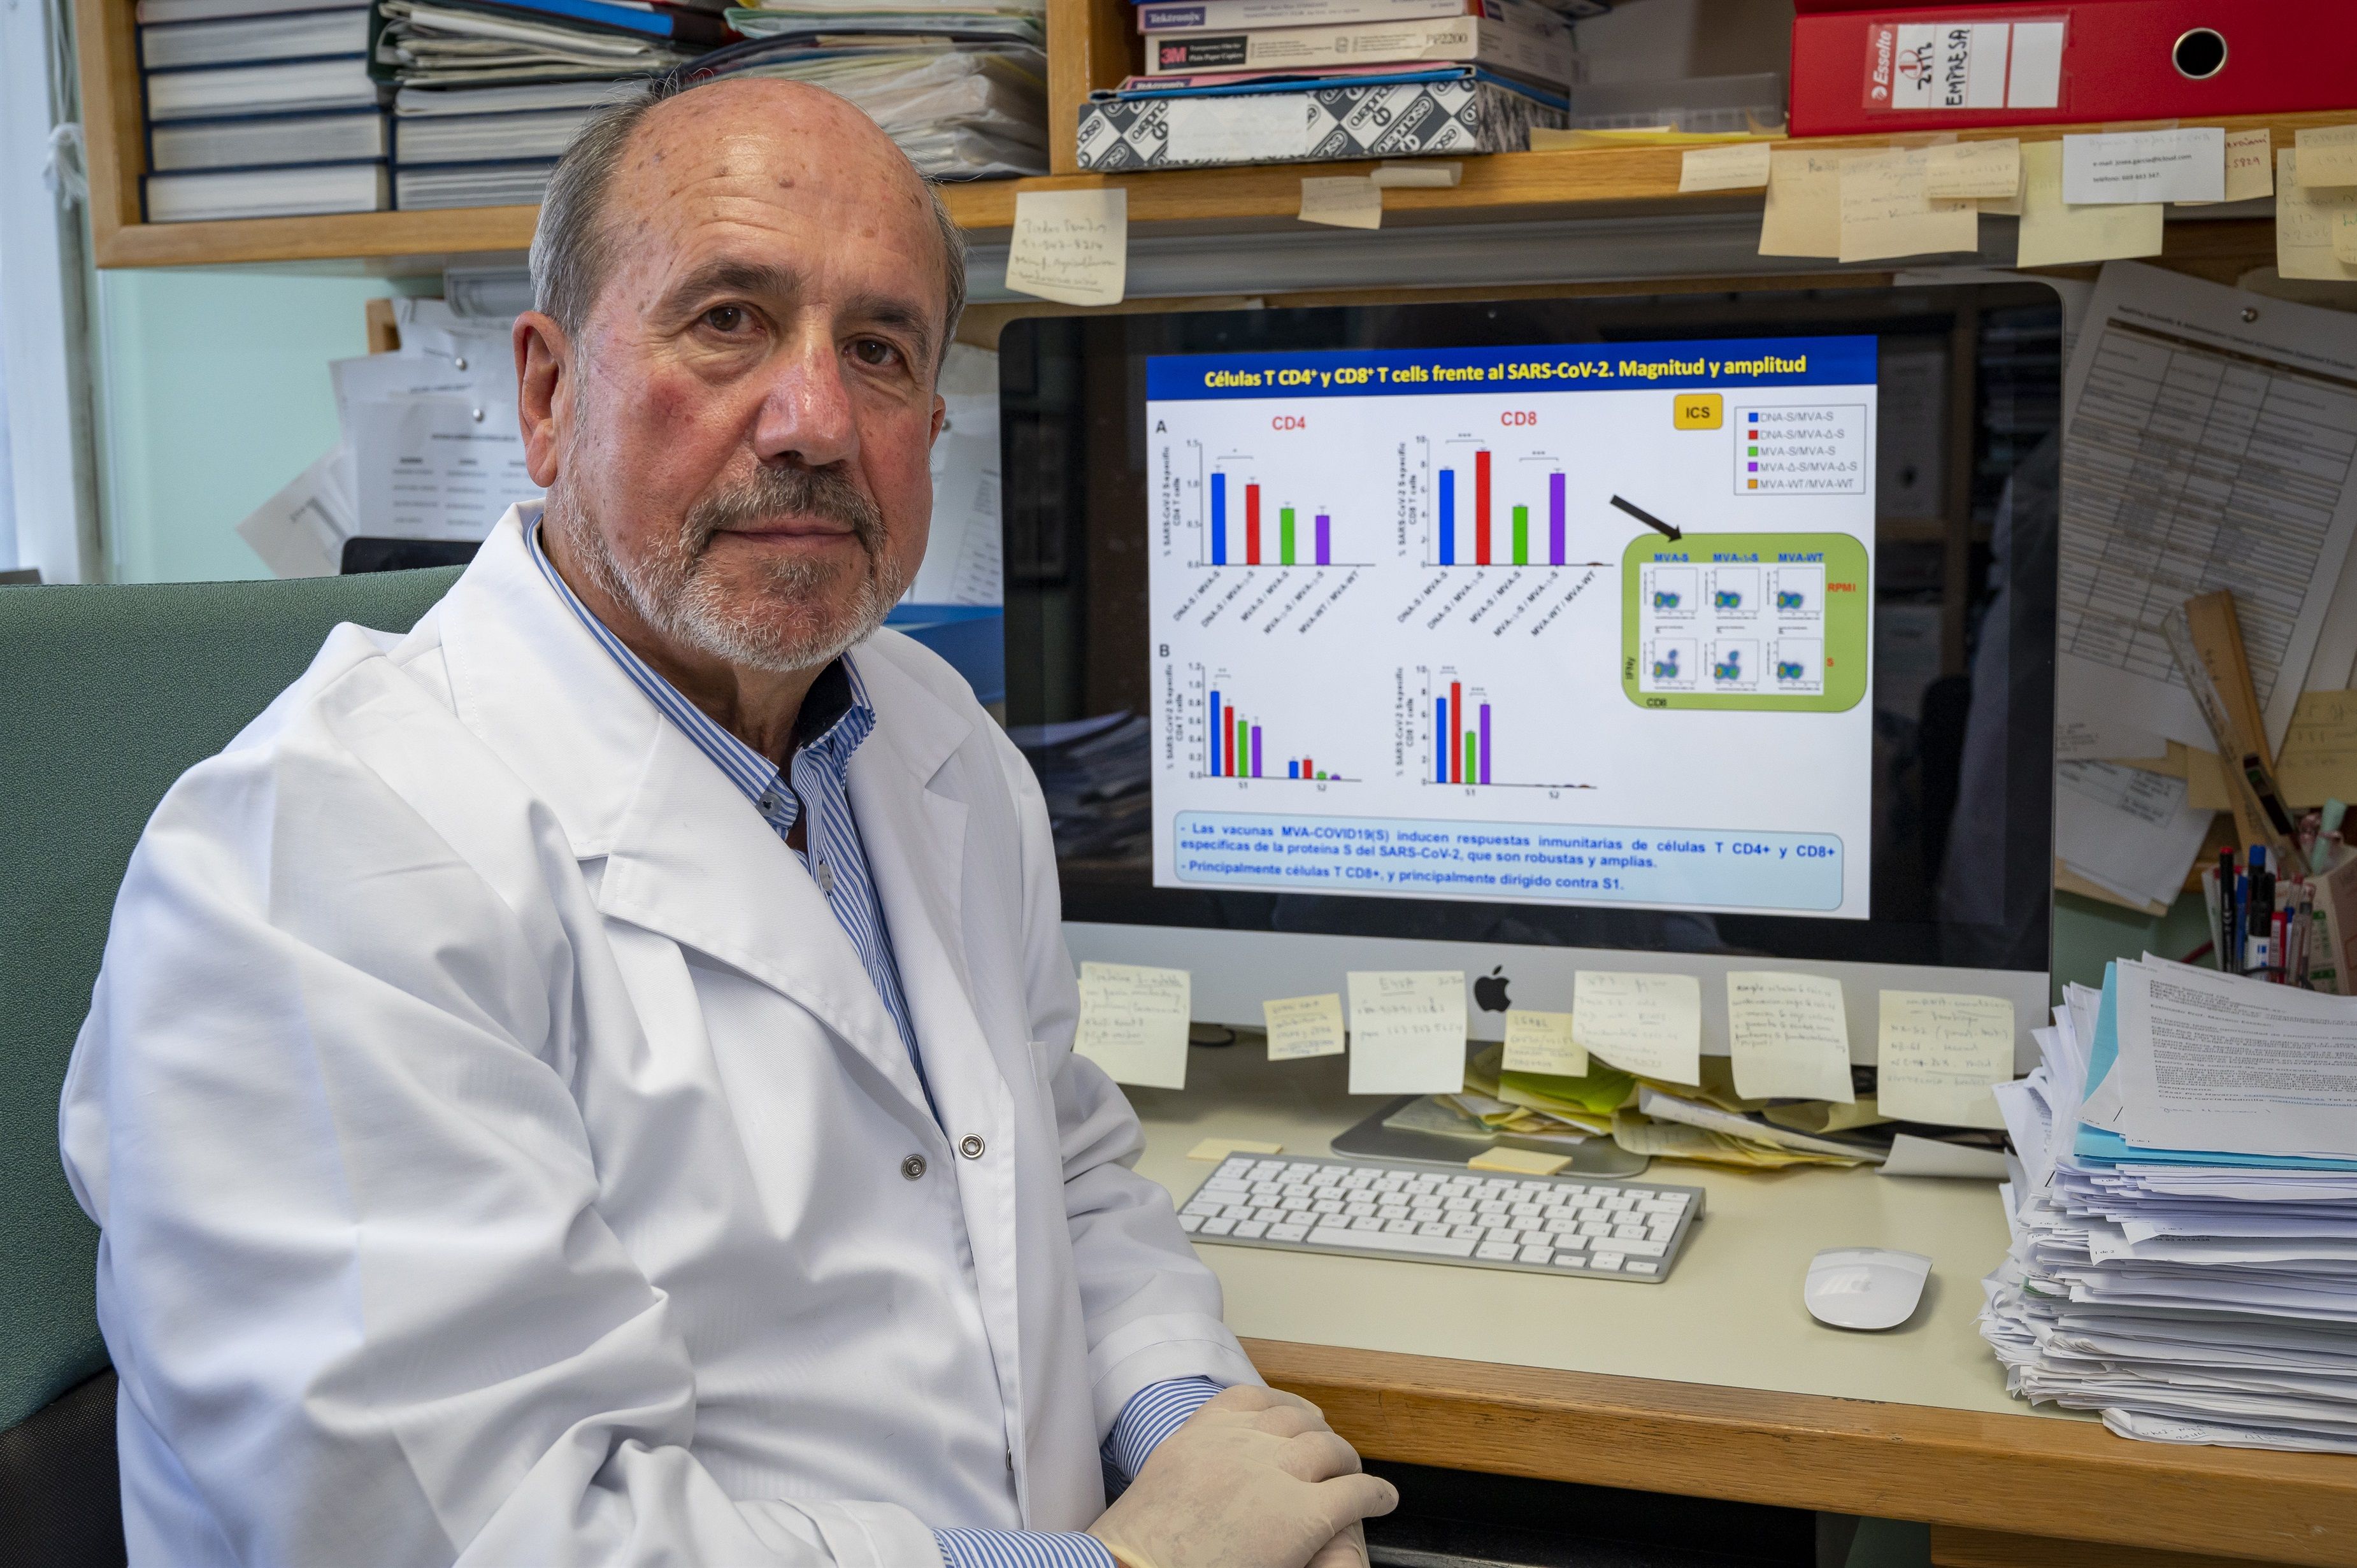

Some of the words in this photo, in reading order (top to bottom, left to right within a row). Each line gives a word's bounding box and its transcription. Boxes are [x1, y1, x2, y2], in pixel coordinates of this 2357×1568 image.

[1160, 46, 1187, 64] 3M
[1873, 30, 1892, 85] Esselte
[1945, 29, 1970, 106] EMPRESA
[1205, 369, 1261, 388] Células
[1264, 370, 1274, 386] T
[1278, 368, 1317, 386] CD4+
[1320, 371, 1331, 388] y
[1335, 366, 1375, 385] CD8+
[1377, 366, 1389, 383] T
[1391, 365, 1429, 383] cells
[1432, 364, 1484, 381] frente
[1488, 362, 1504, 380] al
[1507, 361, 1615, 380] SARS-CoV-2.
[1619, 357, 1705, 380] Magnitud
[1709, 360, 1721, 378] y
[1723, 355, 1807, 377] amplitud
[1501, 412, 1537, 426] CD8
[1686, 406, 1710, 418] ICS
[1760, 411, 1834, 422] DNA-S/MVA-S
[1156, 419, 1167, 434] A
[1272, 416, 1306, 431] CD4
[1760, 446, 1836, 456] MVA-S/MVA-S
[1760, 478, 1854, 489] MVA-WT/MVA-WT
[1654, 553, 1689, 562] MVA-S
[1778, 553, 1824, 562] MVA-WT
[1827, 583, 1856, 592] RPMI
[1159, 644, 1170, 657] B
[1192, 823, 1214, 834] Las
[1221, 826, 1274, 837] vacunas
[1282, 826, 1389, 844] MVA-COVID19(S)
[1396, 830, 1449, 843] inducen
[1456, 834, 1530, 850] respuestas
[1538, 836, 1623, 851] inmunitarias
[1631, 839, 1648, 852] de
[1656, 841, 1705, 853] células
[1716, 842, 1724, 853] T
[1732, 843, 1770, 855] CD4+
[1779, 847, 1788, 859] y
[1796, 845, 1835, 858] CD8+
[1254, 840, 1270, 852] de
[1272, 841, 1284, 853] la
[1344, 845, 1352, 855] S
[1356, 844, 1375, 857] del
[1468, 851, 1492, 863] que
[1496, 852, 1521, 862] son
[1525, 853, 1584, 866] robustas
[1588, 856, 1596, 867] y
[1189, 860, 1280, 875] Principalmente
[1286, 864, 1329, 877] células
[1334, 866, 1342, 877] T
[1387, 871, 1394, 883] y
[1400, 870, 1496, 885] principalmente
[1500, 873, 1551, 889] dirigido
[1555, 877, 1598, 890] contra
